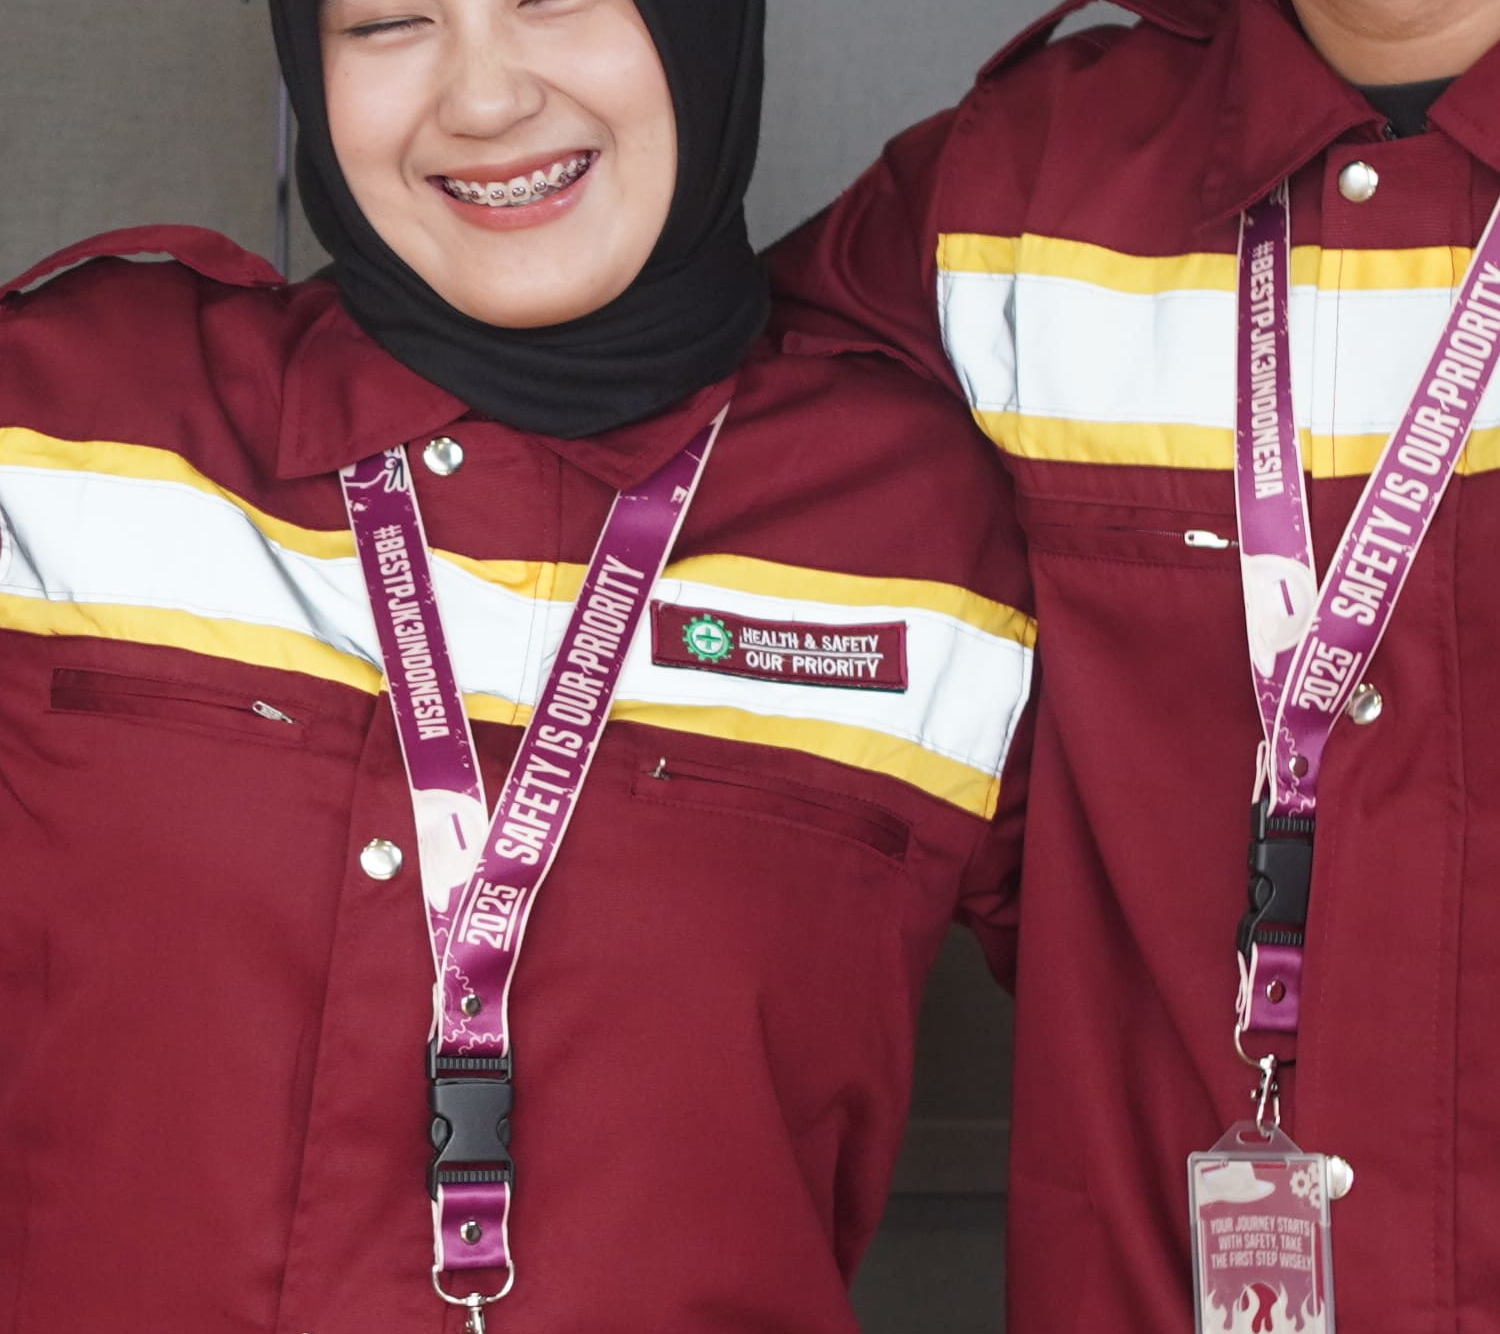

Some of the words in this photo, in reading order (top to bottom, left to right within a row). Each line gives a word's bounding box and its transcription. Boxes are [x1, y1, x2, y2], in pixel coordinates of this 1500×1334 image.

[1249, 240, 1285, 500] #BESTPJK3INDONESIA
[1398, 408, 1460, 478] OUR
[1380, 472, 1432, 519] IS
[1332, 507, 1413, 627] SAFETY
[371, 525, 450, 742] #BESTPJK3INDONESIA
[567, 553, 646, 674] PRIORITY
[740, 626, 798, 650] HEALTH
[804, 633, 817, 650] &
[822, 634, 879, 654] SAFETY
[746, 652, 783, 671] OUR
[792, 655, 879, 678] PRIORITY
[1299, 642, 1355, 714] 2025
[546, 670, 604, 729] OUR
[534, 724, 584, 760] IS
[495, 755, 572, 867] SAFETY
[467, 883, 519, 950] 2025
[1210, 1216, 1234, 1235] YOUR
[1235, 1215, 1275, 1232] JOURNEY
[1276, 1216, 1310, 1237] STARTS
[1218, 1234, 1242, 1251] WITH
[1281, 1235, 1303, 1252] TAKE
[1211, 1252, 1228, 1269] THE
[1229, 1251, 1254, 1267] FIRST
[1255, 1251, 1278, 1267] STEP
[1279, 1251, 1312, 1271] WISELY
